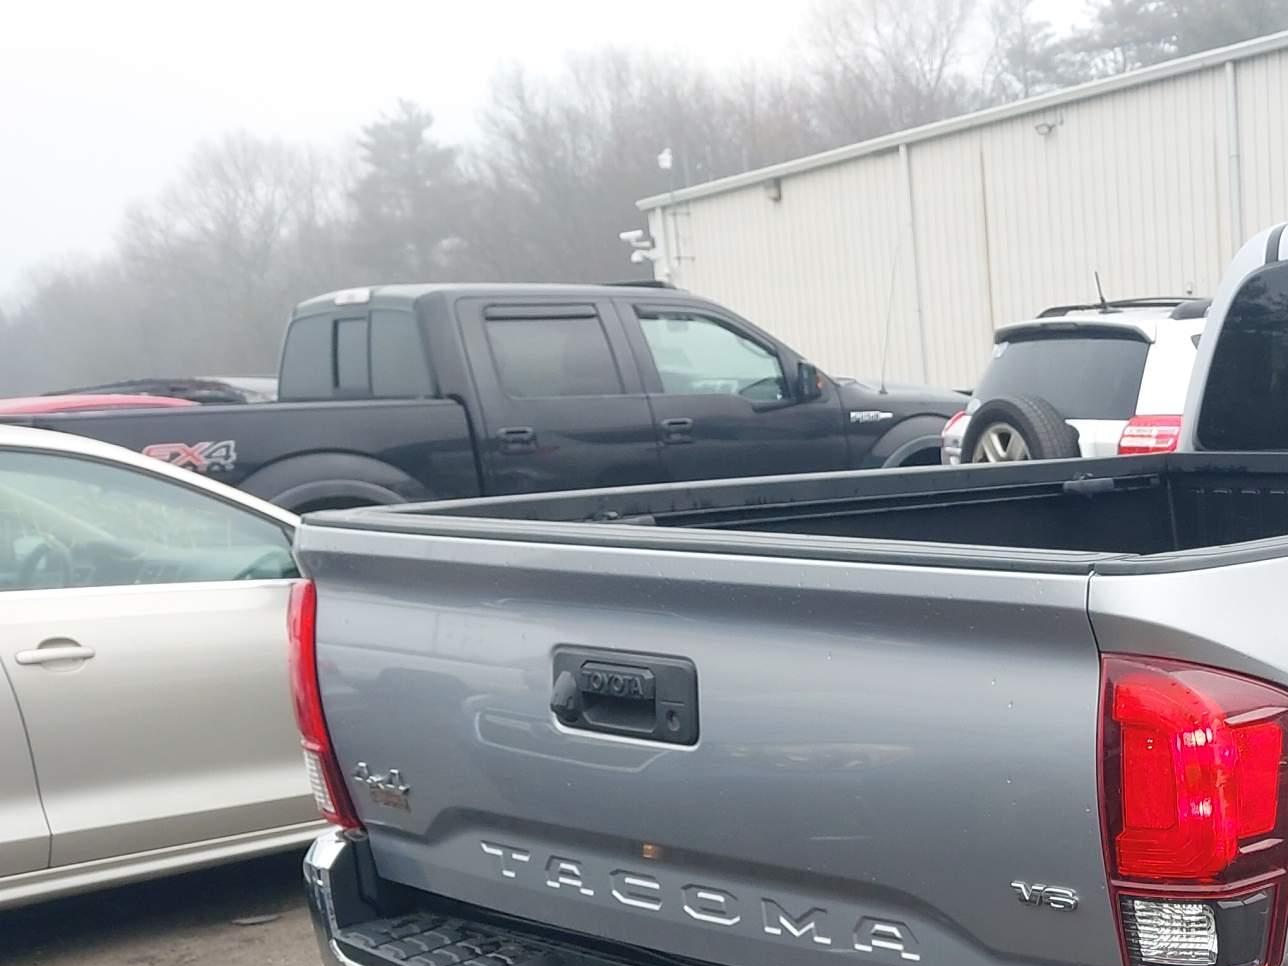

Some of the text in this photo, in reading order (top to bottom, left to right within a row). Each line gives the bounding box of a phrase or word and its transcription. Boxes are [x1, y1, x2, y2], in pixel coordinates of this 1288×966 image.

[581, 670, 644, 696] TOYOTA
[480, 840, 921, 961] TACOMA
[1010, 880, 1079, 911] V6
